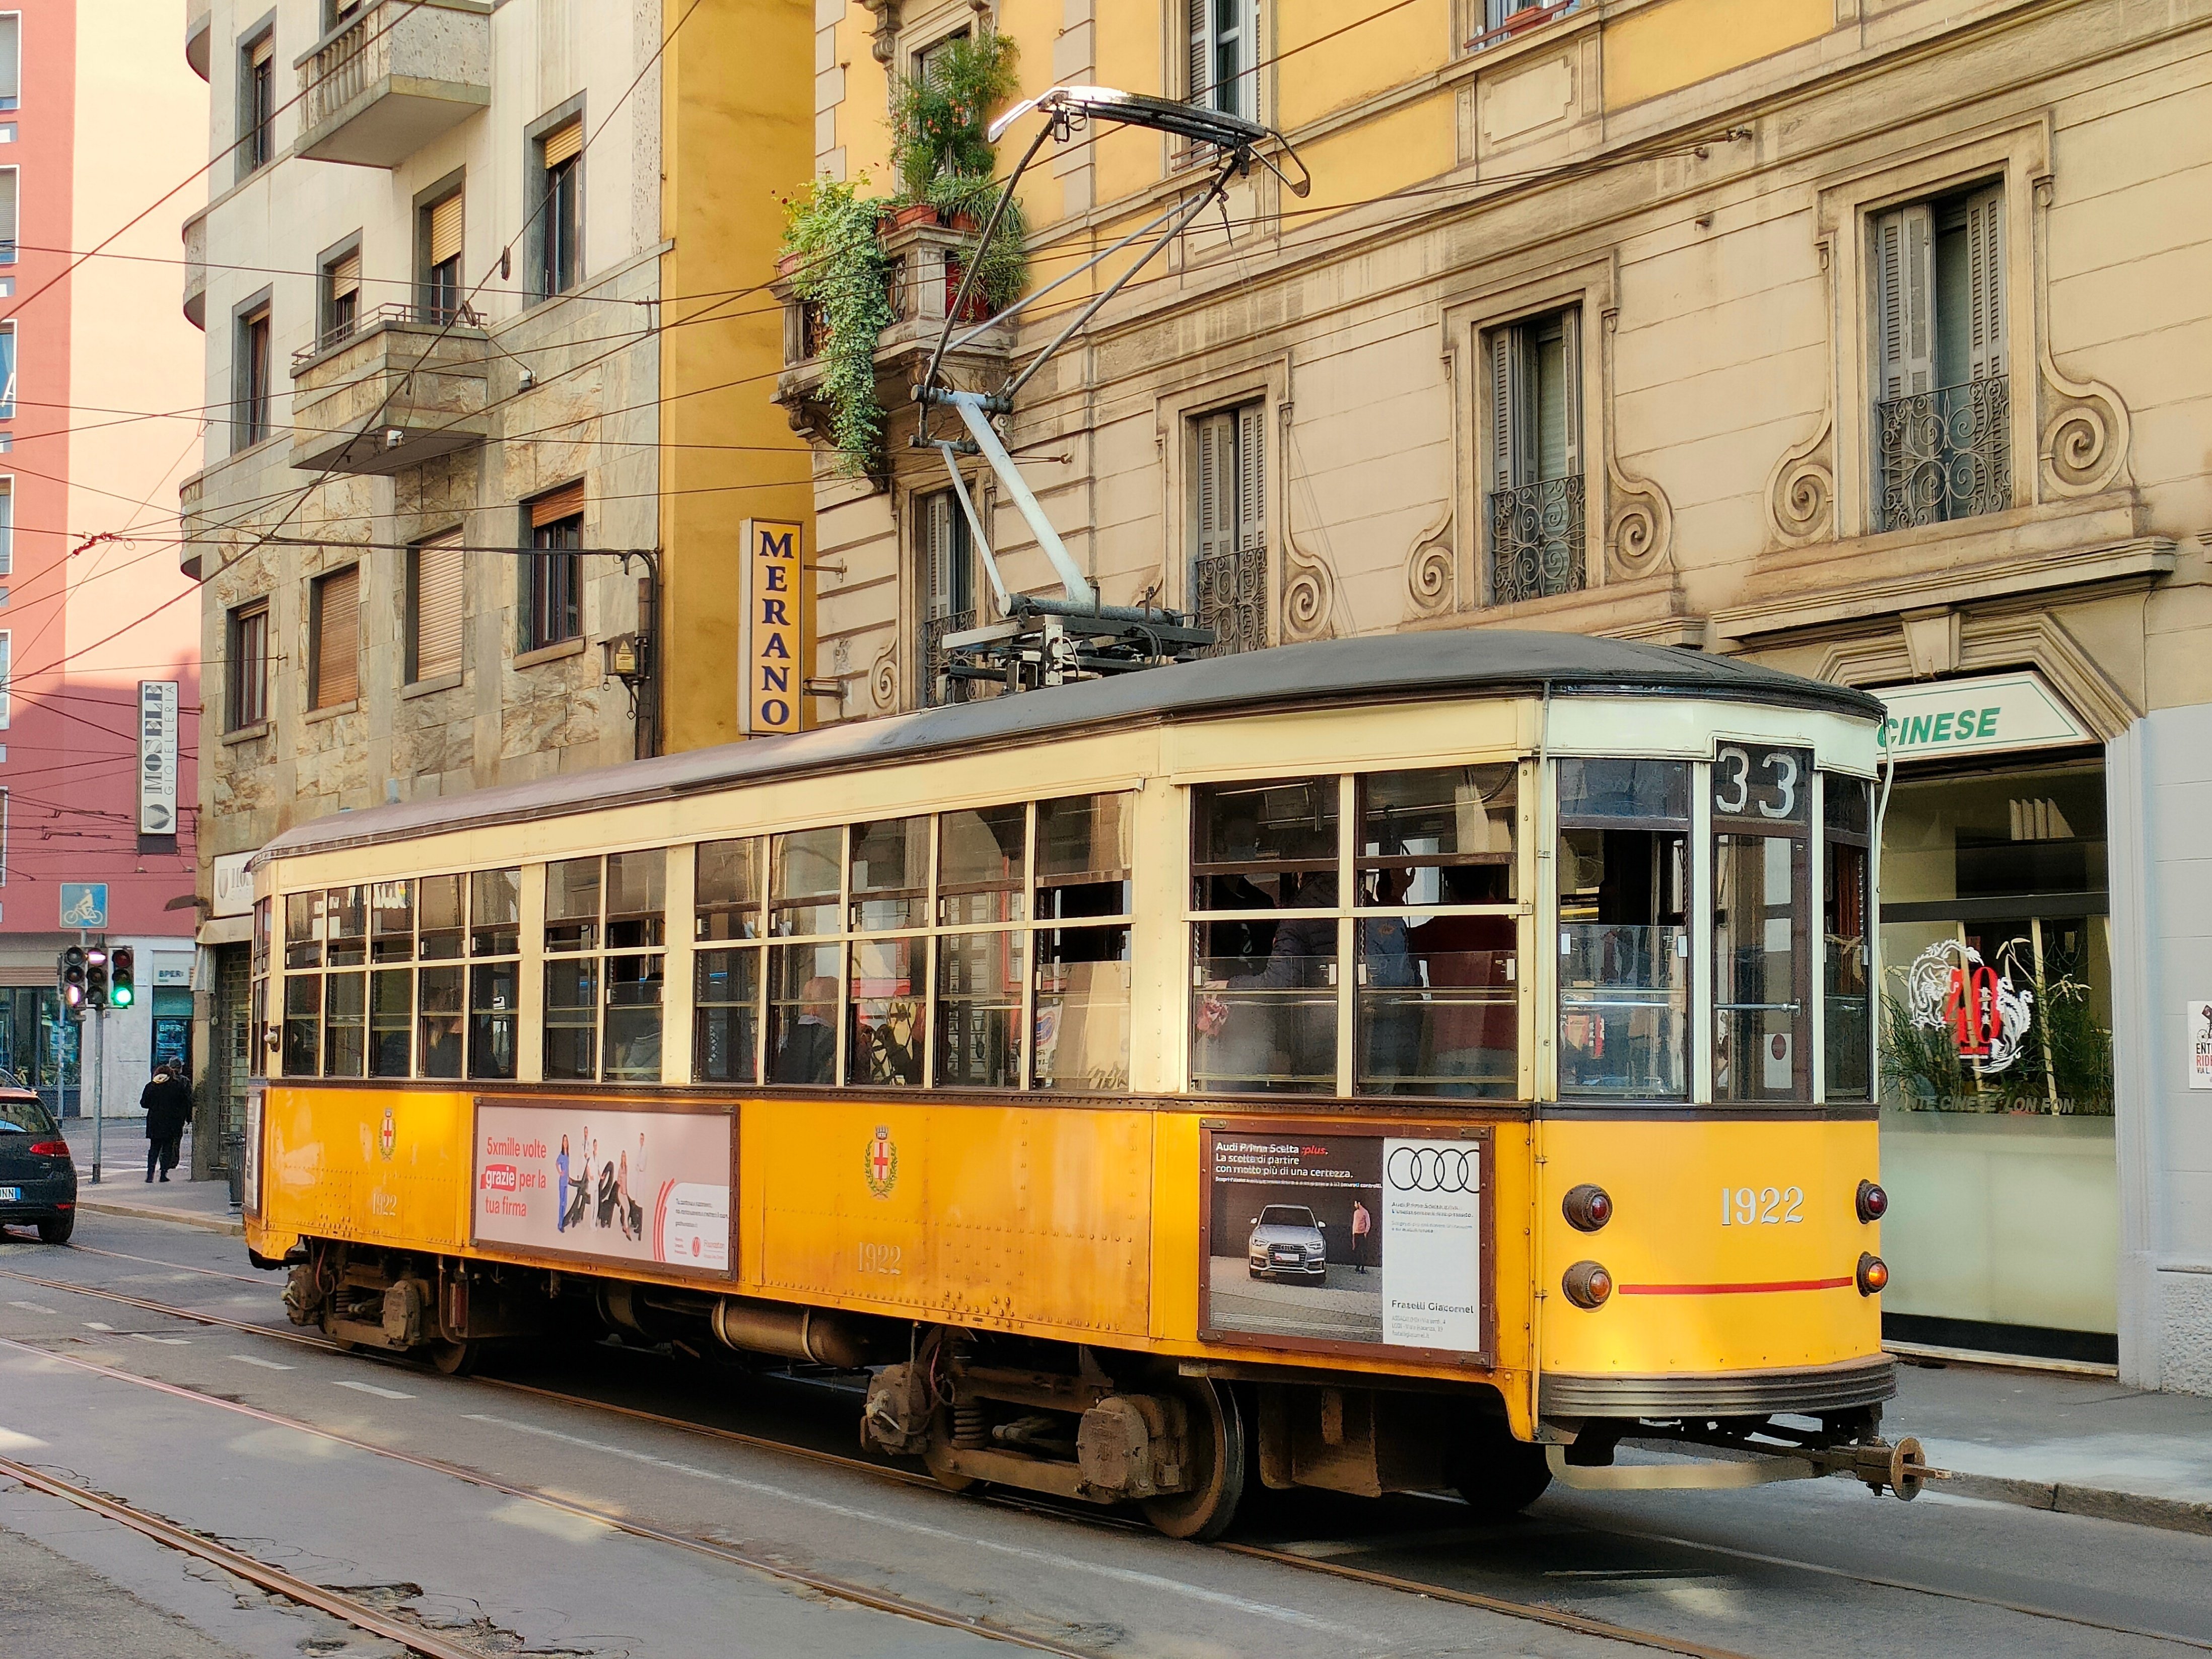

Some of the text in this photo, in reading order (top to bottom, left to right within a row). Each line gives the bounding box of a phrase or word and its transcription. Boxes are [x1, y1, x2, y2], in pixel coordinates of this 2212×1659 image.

[759, 530, 794, 725] MERANO
[1877, 707, 2000, 747] CINESE
[164, 685, 174, 795] GIOIELLERIA
[1716, 747, 1797, 818] 33
[2196, 1043, 2212, 1054] ENT
[487, 1137, 546, 1158] 5xmille volte
[1216, 1143, 1238, 1151] Audi
[1240, 1143, 1268, 1153] Prima
[1270, 1144, 1299, 1153] Scelta
[1216, 1153, 1226, 1162] La
[1258, 1155, 1266, 1163] di
[1268, 1155, 1299, 1165] partire
[486, 1166, 546, 1192] grazie per la
[1264, 1166, 1277, 1176] più
[1280, 1167, 1288, 1175] di
[1310, 1169, 1353, 1179] certezza.
[373, 1193, 397, 1216] 1922
[486, 1196, 526, 1216] tua firma
[1722, 1187, 1804, 1225] 1922
[858, 1242, 902, 1275] 1922
[1392, 1300, 1474, 1314] Fratelli Giacomel
